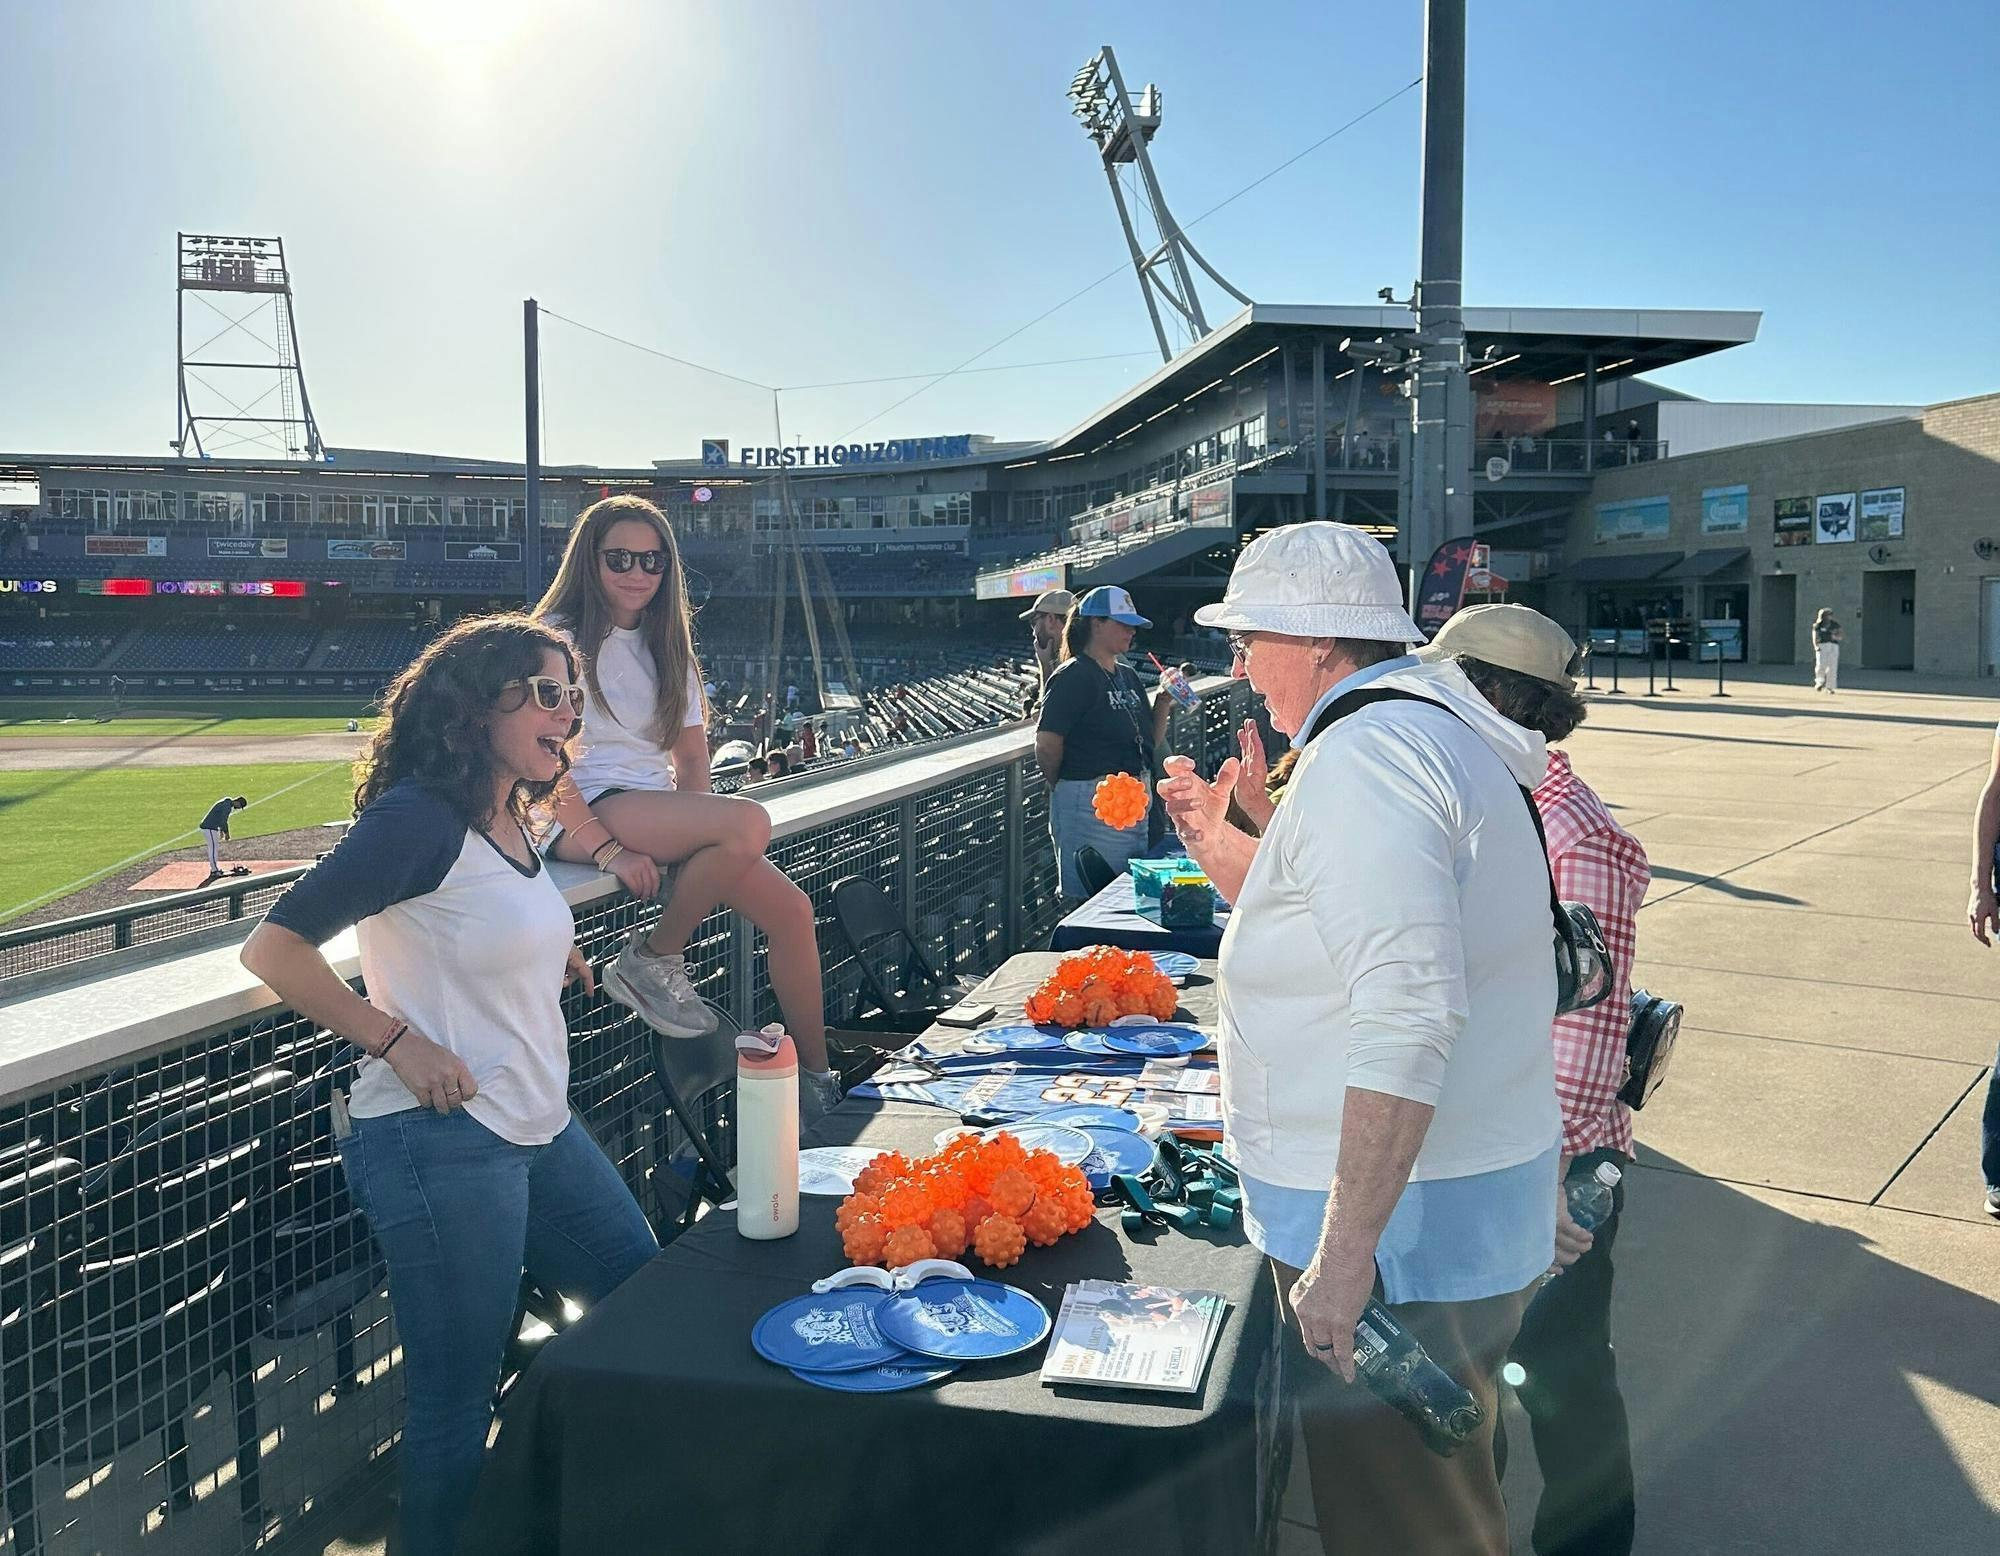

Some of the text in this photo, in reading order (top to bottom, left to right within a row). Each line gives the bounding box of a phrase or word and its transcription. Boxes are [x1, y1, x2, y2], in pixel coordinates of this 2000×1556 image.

[740, 446, 810, 467] FIRST
[814, 438, 919, 466] HORIZON
[847, 544, 861, 552] Club
[943, 542, 957, 551] Club
[0, 579, 58, 593] UNDS
[771, 1193, 779, 1222] owala
[1060, 1354, 1079, 1373] LEARN
[1168, 1346, 1183, 1369] KEHILLA
